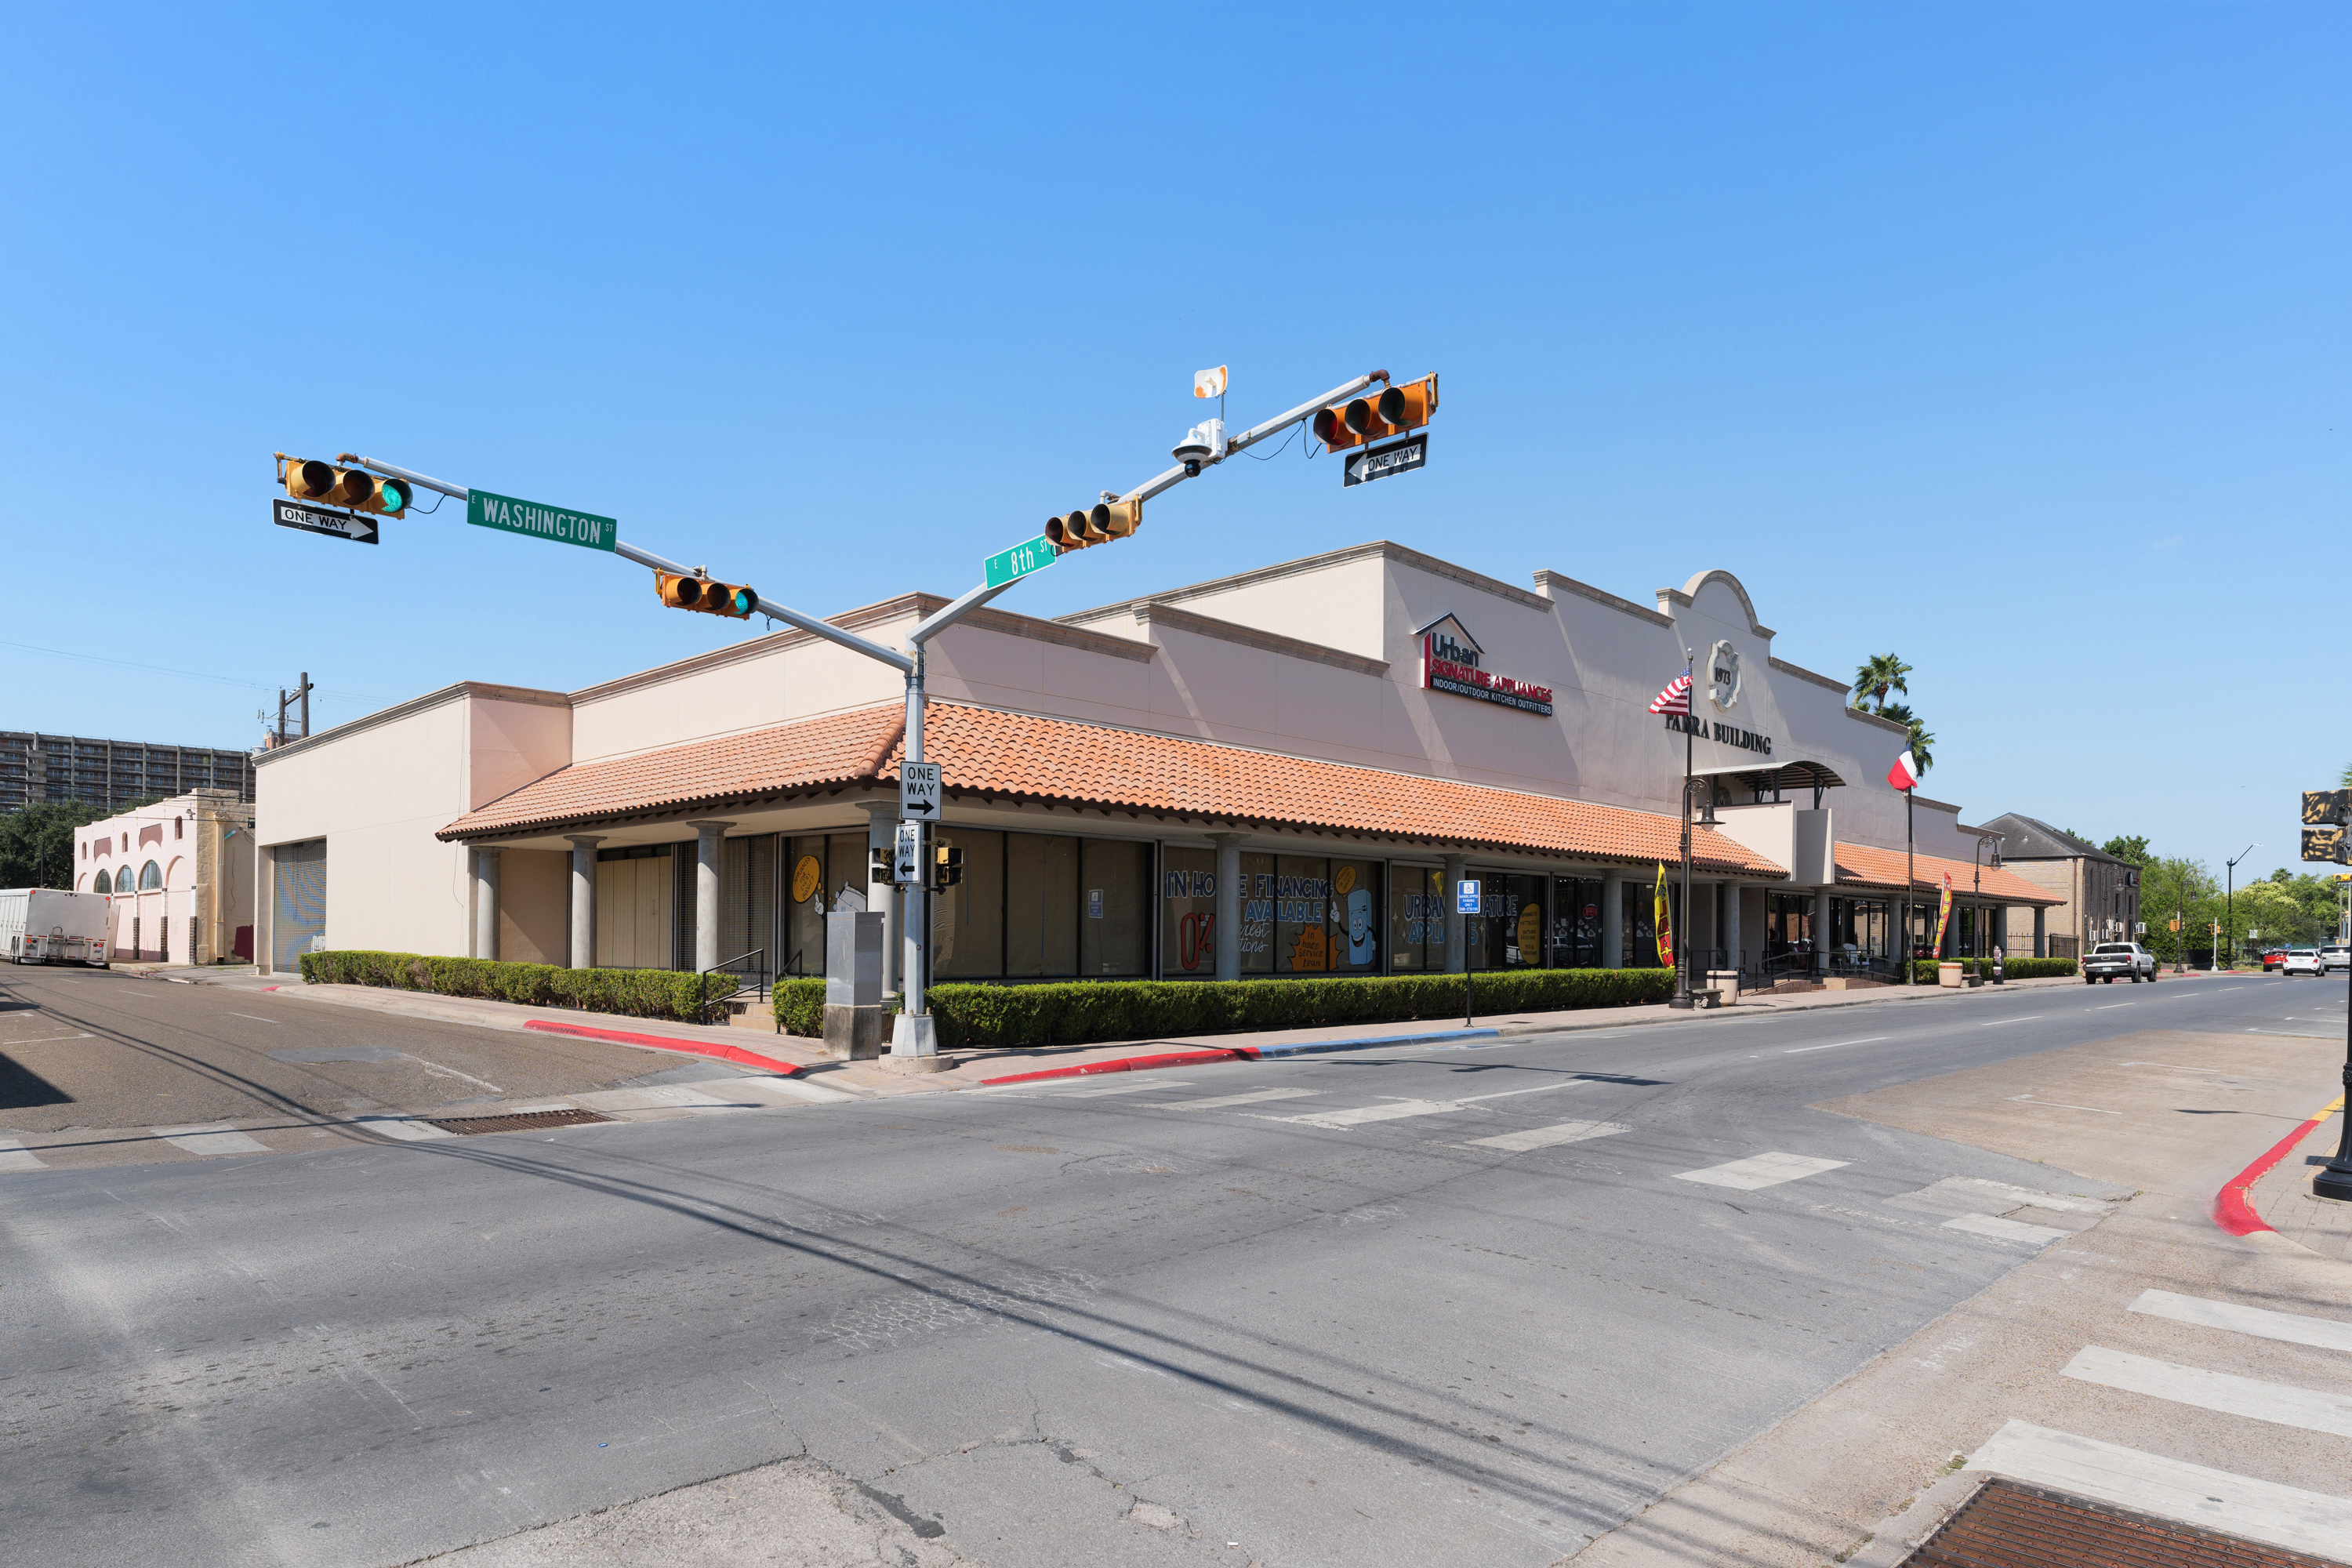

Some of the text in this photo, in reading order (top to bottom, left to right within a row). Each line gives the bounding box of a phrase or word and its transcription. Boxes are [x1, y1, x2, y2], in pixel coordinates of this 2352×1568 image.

[1368, 446, 1417, 471] ONE WAY
[285, 509, 347, 530] ONE WAY
[472, 495, 613, 544] E WASHINGTON ST
[994, 539, 1047, 575] E 8th ST
[1432, 632, 1479, 667] Urban
[1431, 659, 1552, 702] SIGNATURE APPLIANCES
[1715, 666, 1731, 686] 1973
[1433, 677, 1552, 714] INDOOR/OUTDOOR KITCHEN OUTFITTERS
[1713, 722, 1771, 755] BUILDING
[908, 767, 935, 781] ONE
[907, 782, 935, 796] WAY
[899, 829, 915, 842] ONE
[898, 844, 915, 858] WAY
[1167, 870, 1189, 898] IN
[1255, 873, 1334, 899] FINANCING
[1244, 900, 1323, 924] AVALABLE
[1582, 906, 1598, 916] OPEN
[1934, 889, 1951, 947] OPEN
[1180, 913, 1215, 971] 0%
[1302, 940, 1319, 950] house
[1303, 958, 1321, 967] team
